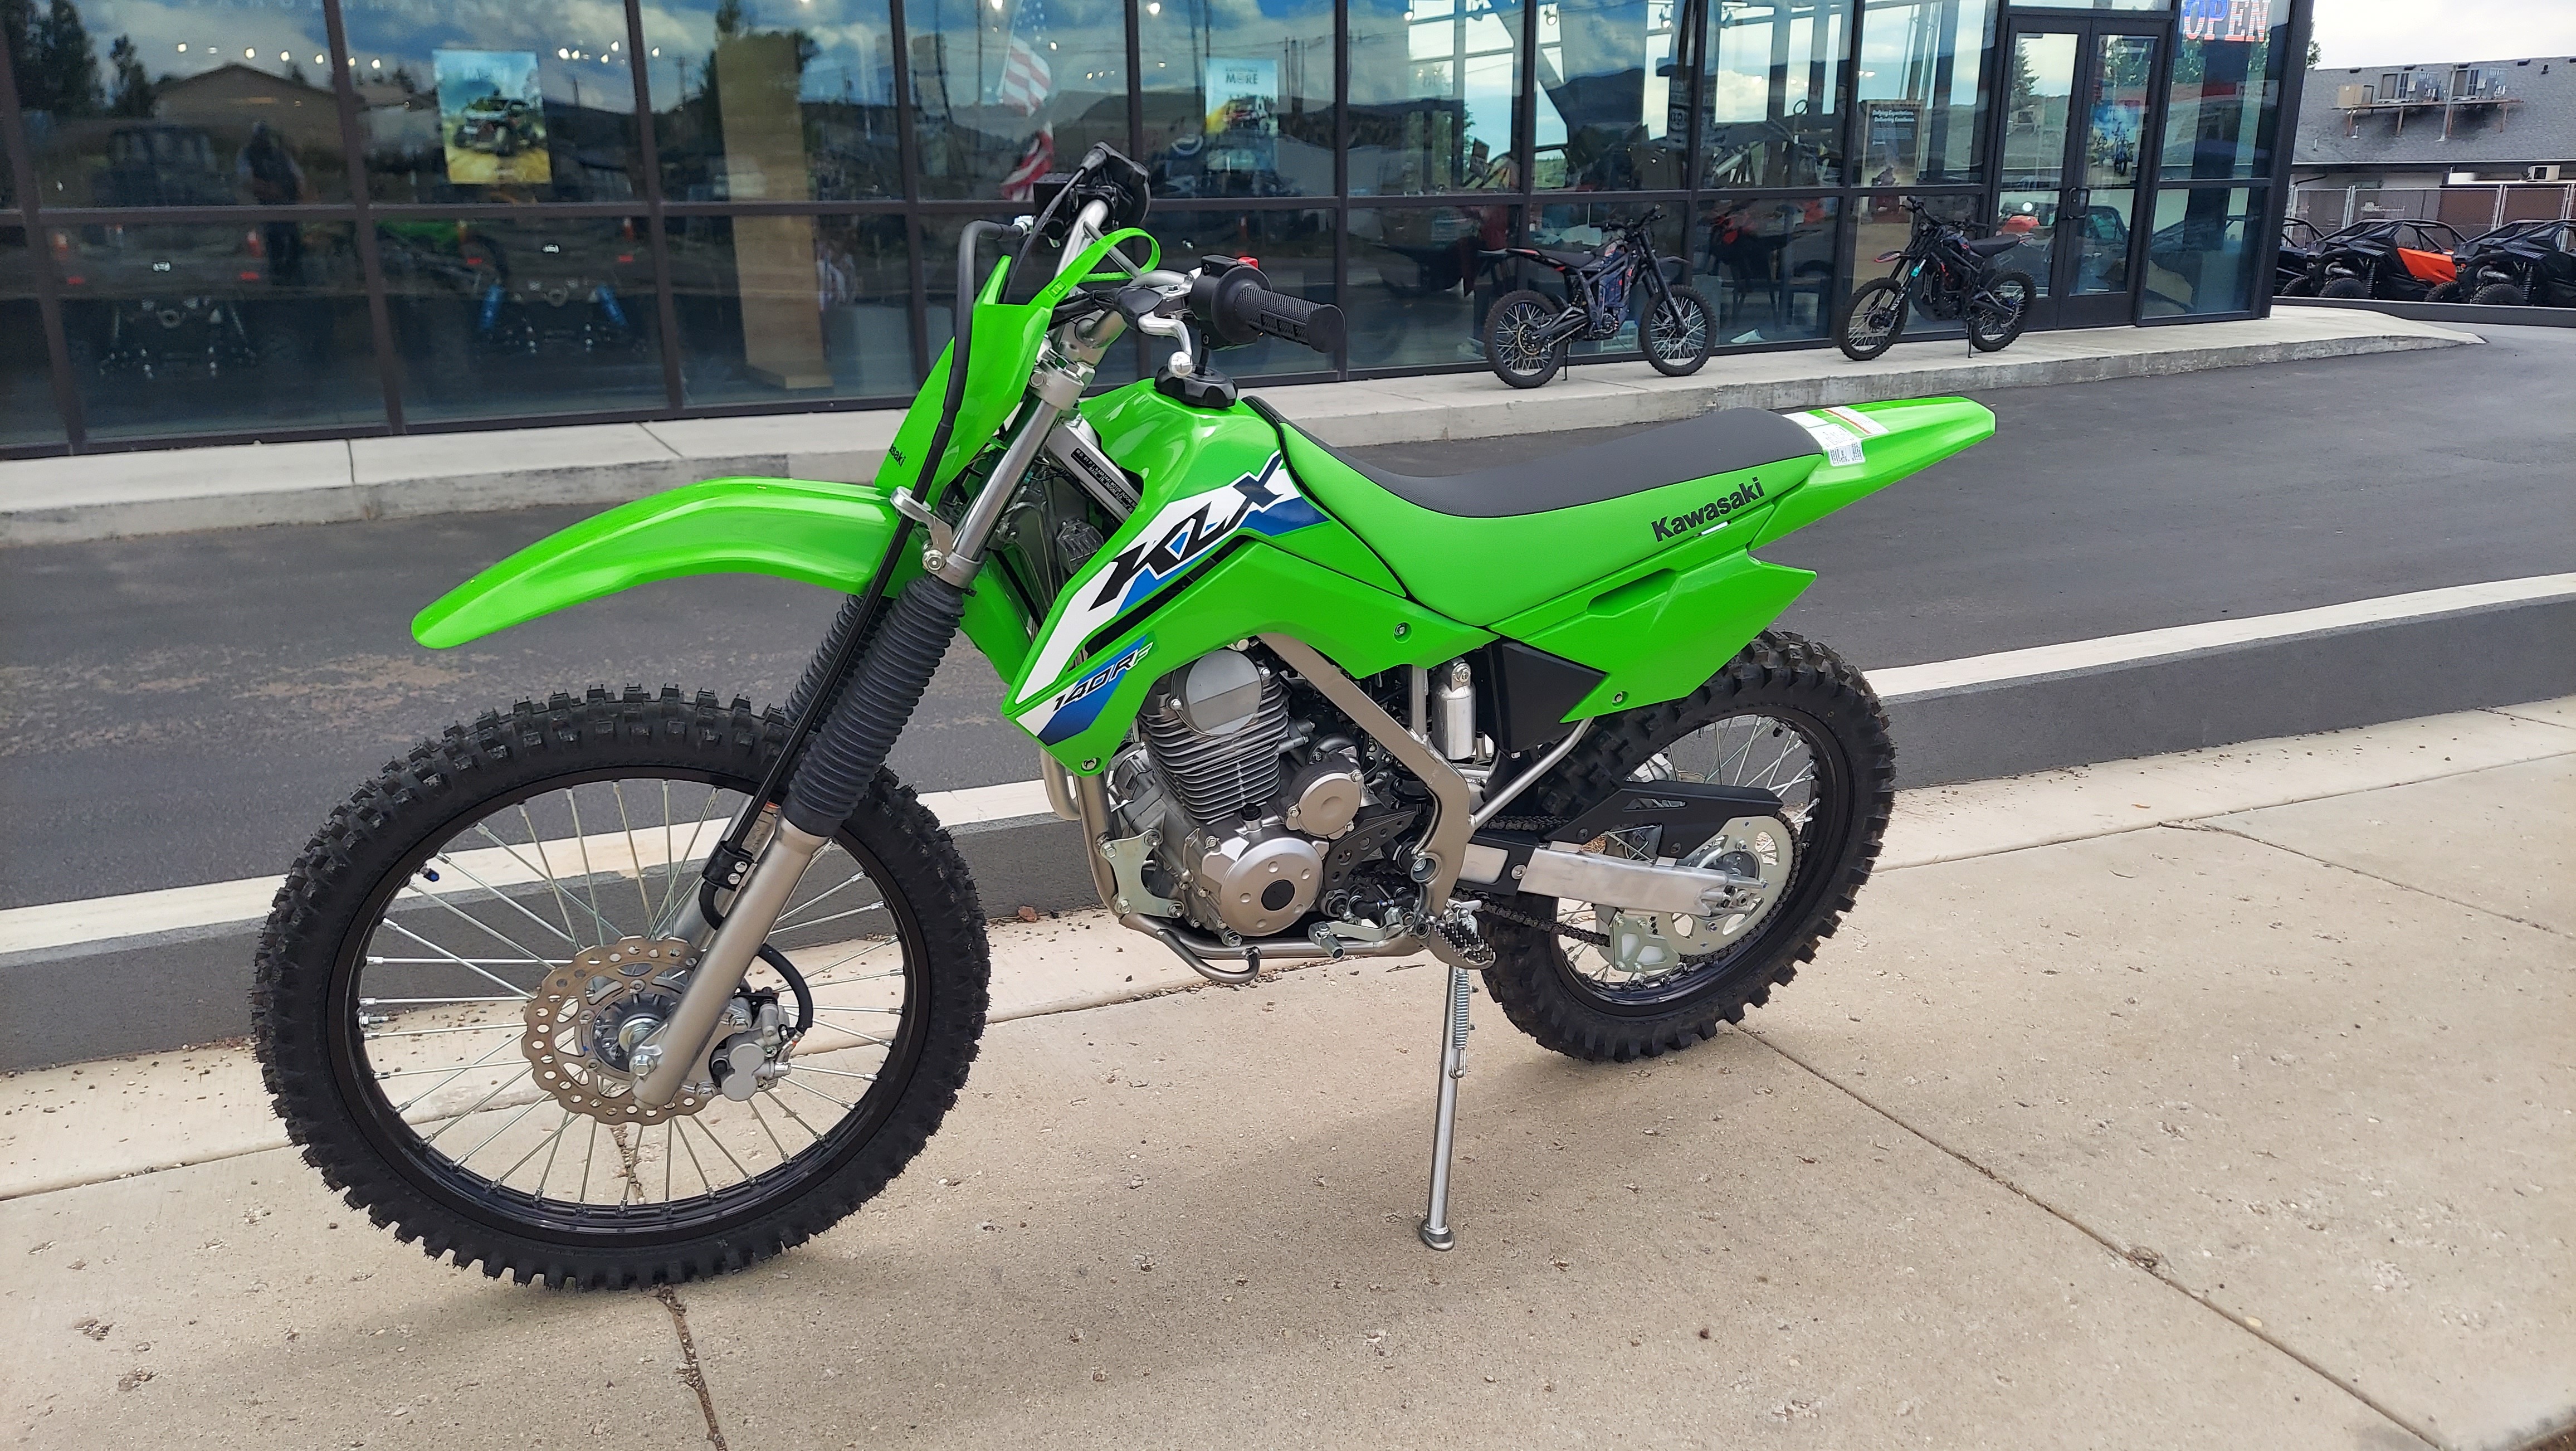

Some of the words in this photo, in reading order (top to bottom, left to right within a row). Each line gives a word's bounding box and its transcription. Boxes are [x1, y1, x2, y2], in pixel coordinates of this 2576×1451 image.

[2184, 0, 2271, 42] OPEN
[1087, 452, 1284, 612] KLX
[1651, 476, 1765, 542] Kawasaki
[1053, 642, 1153, 712] 140RF
